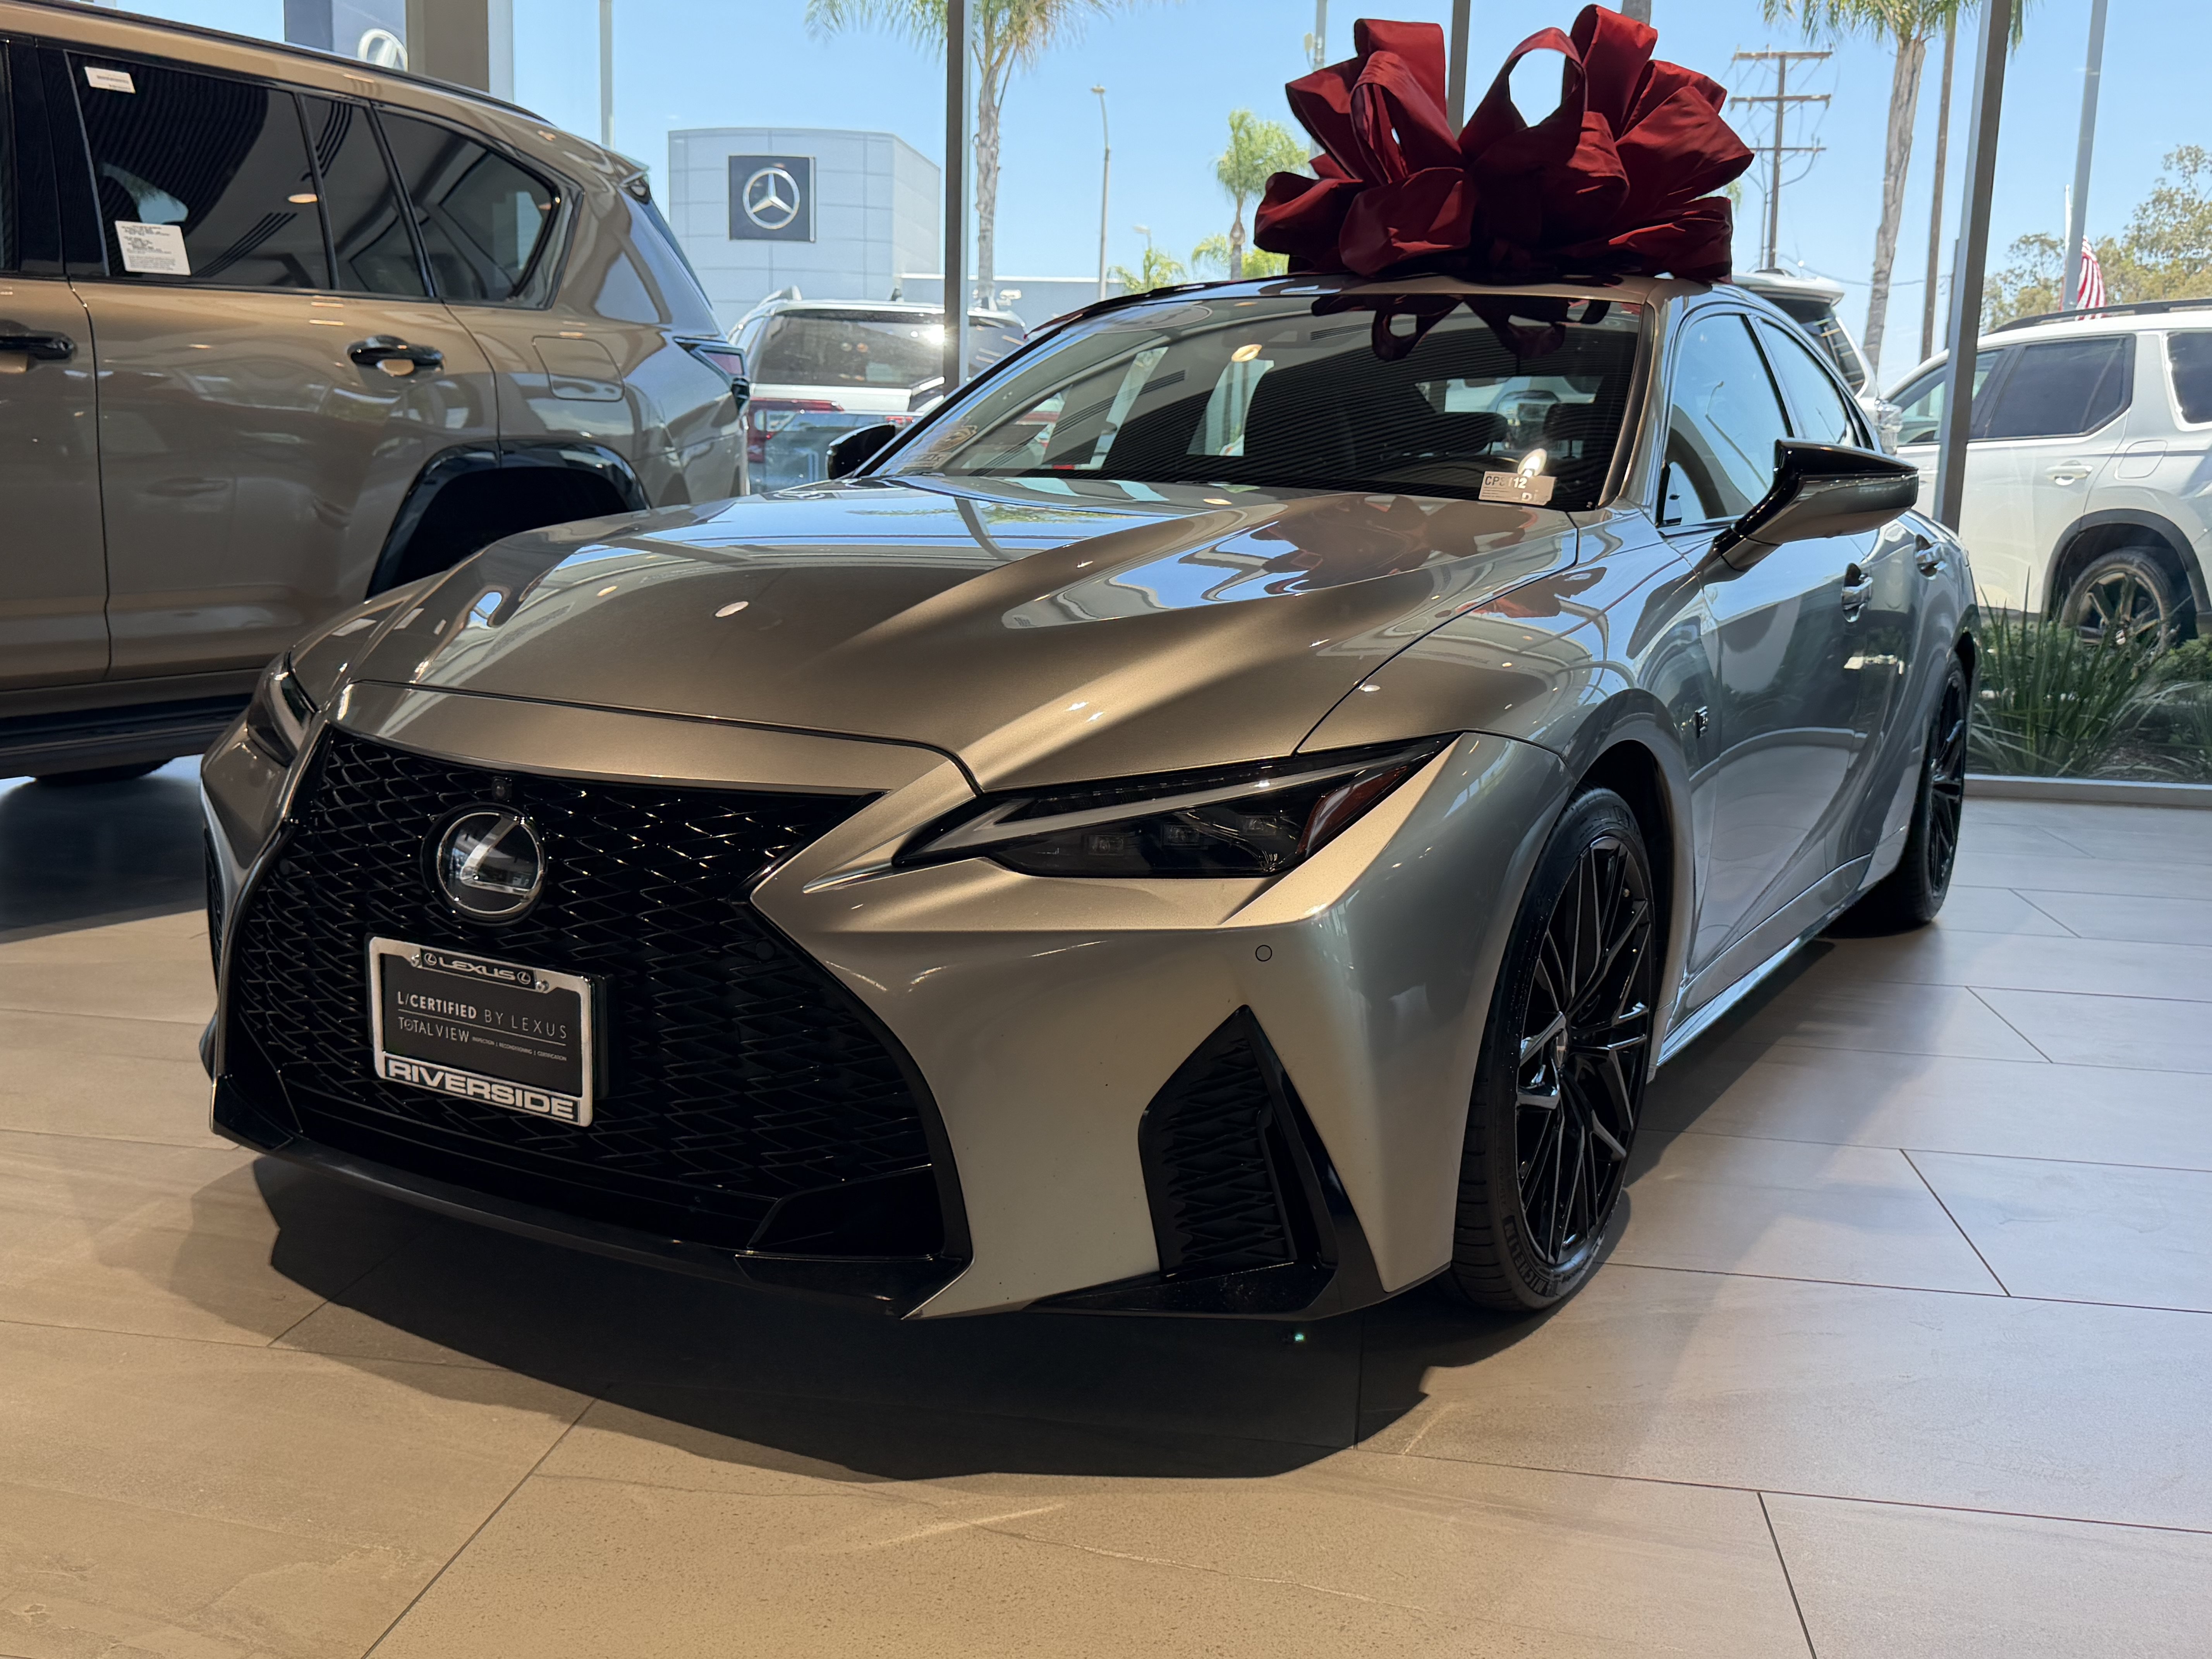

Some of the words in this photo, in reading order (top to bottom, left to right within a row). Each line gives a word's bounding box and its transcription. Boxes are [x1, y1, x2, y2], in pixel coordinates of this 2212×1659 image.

[439, 957, 515, 981] LEXUS
[398, 991, 477, 1019] L/CERTIFIED
[485, 1009, 503, 1025] BY
[512, 1015, 567, 1039] LEXUS
[388, 1059, 574, 1120] RIVERSIDE
[1504, 1221, 1547, 1293] MICHELIN
